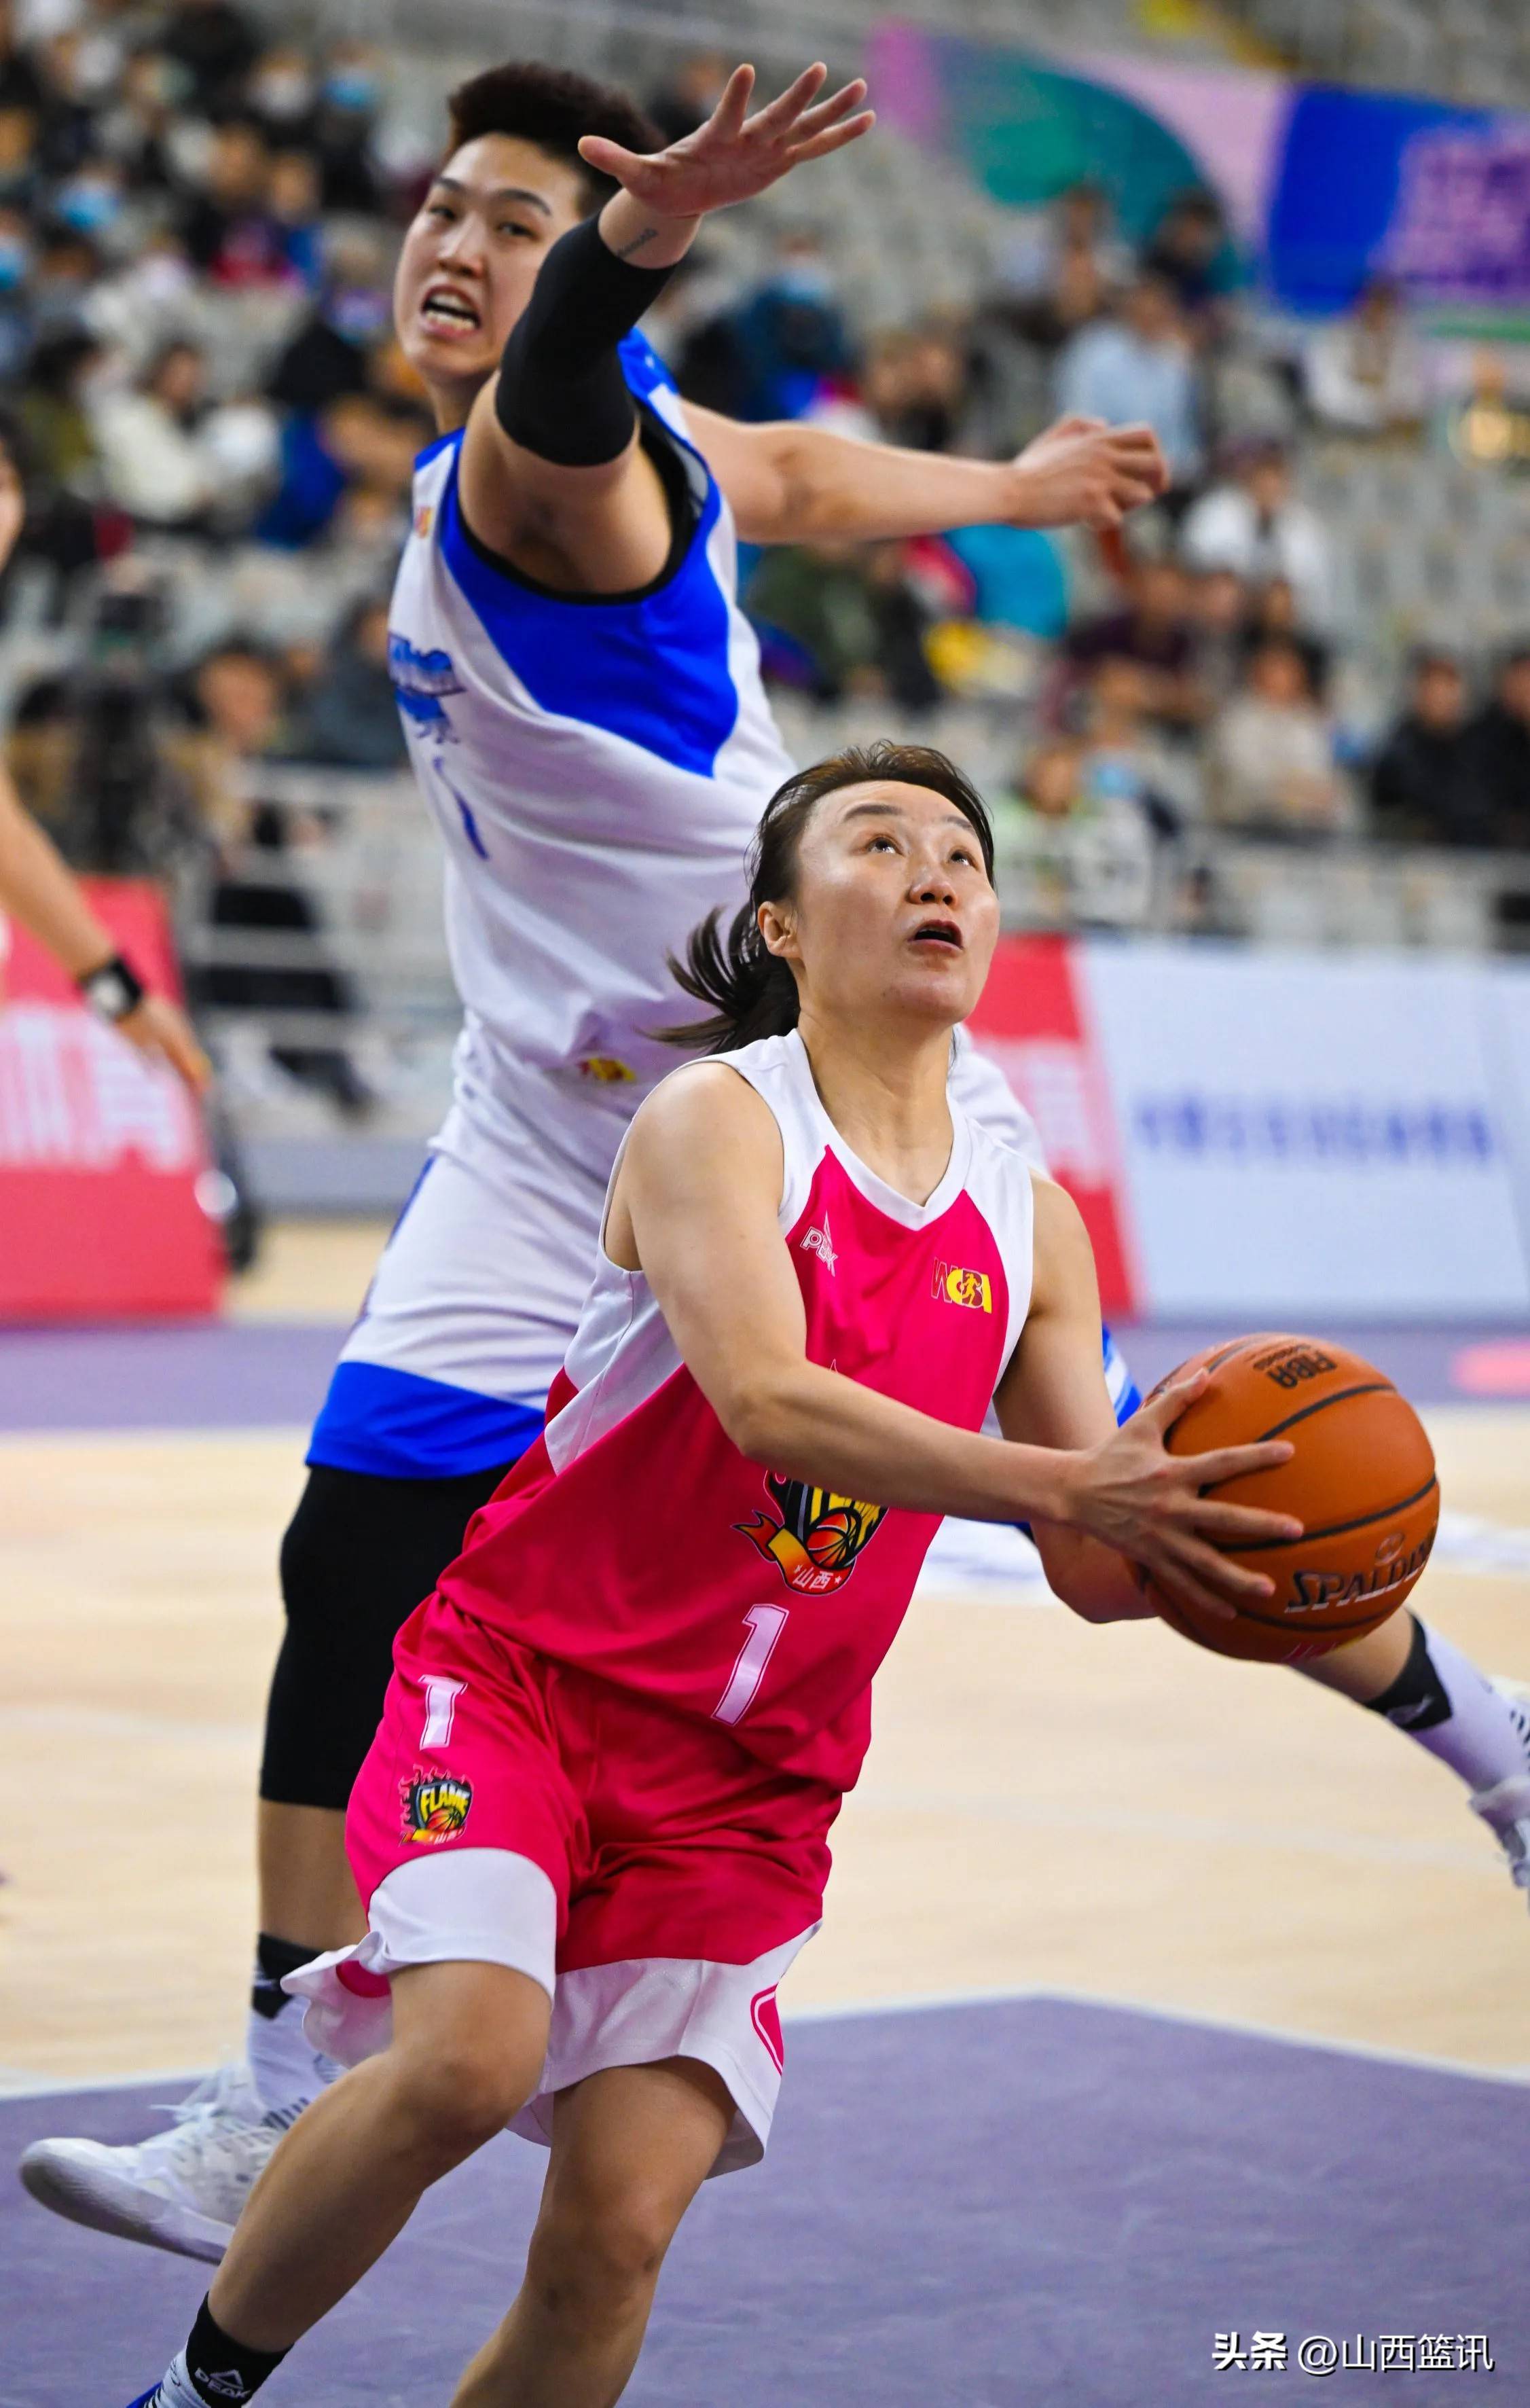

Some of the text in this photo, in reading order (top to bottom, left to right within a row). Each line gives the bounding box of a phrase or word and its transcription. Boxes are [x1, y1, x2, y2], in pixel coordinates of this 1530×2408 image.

[792, 1566, 834, 1589] 山西
[1283, 1527, 1436, 1613] SPALDIN
[711, 1603, 790, 1727] 1
[420, 1782, 471, 1823] FLAME
